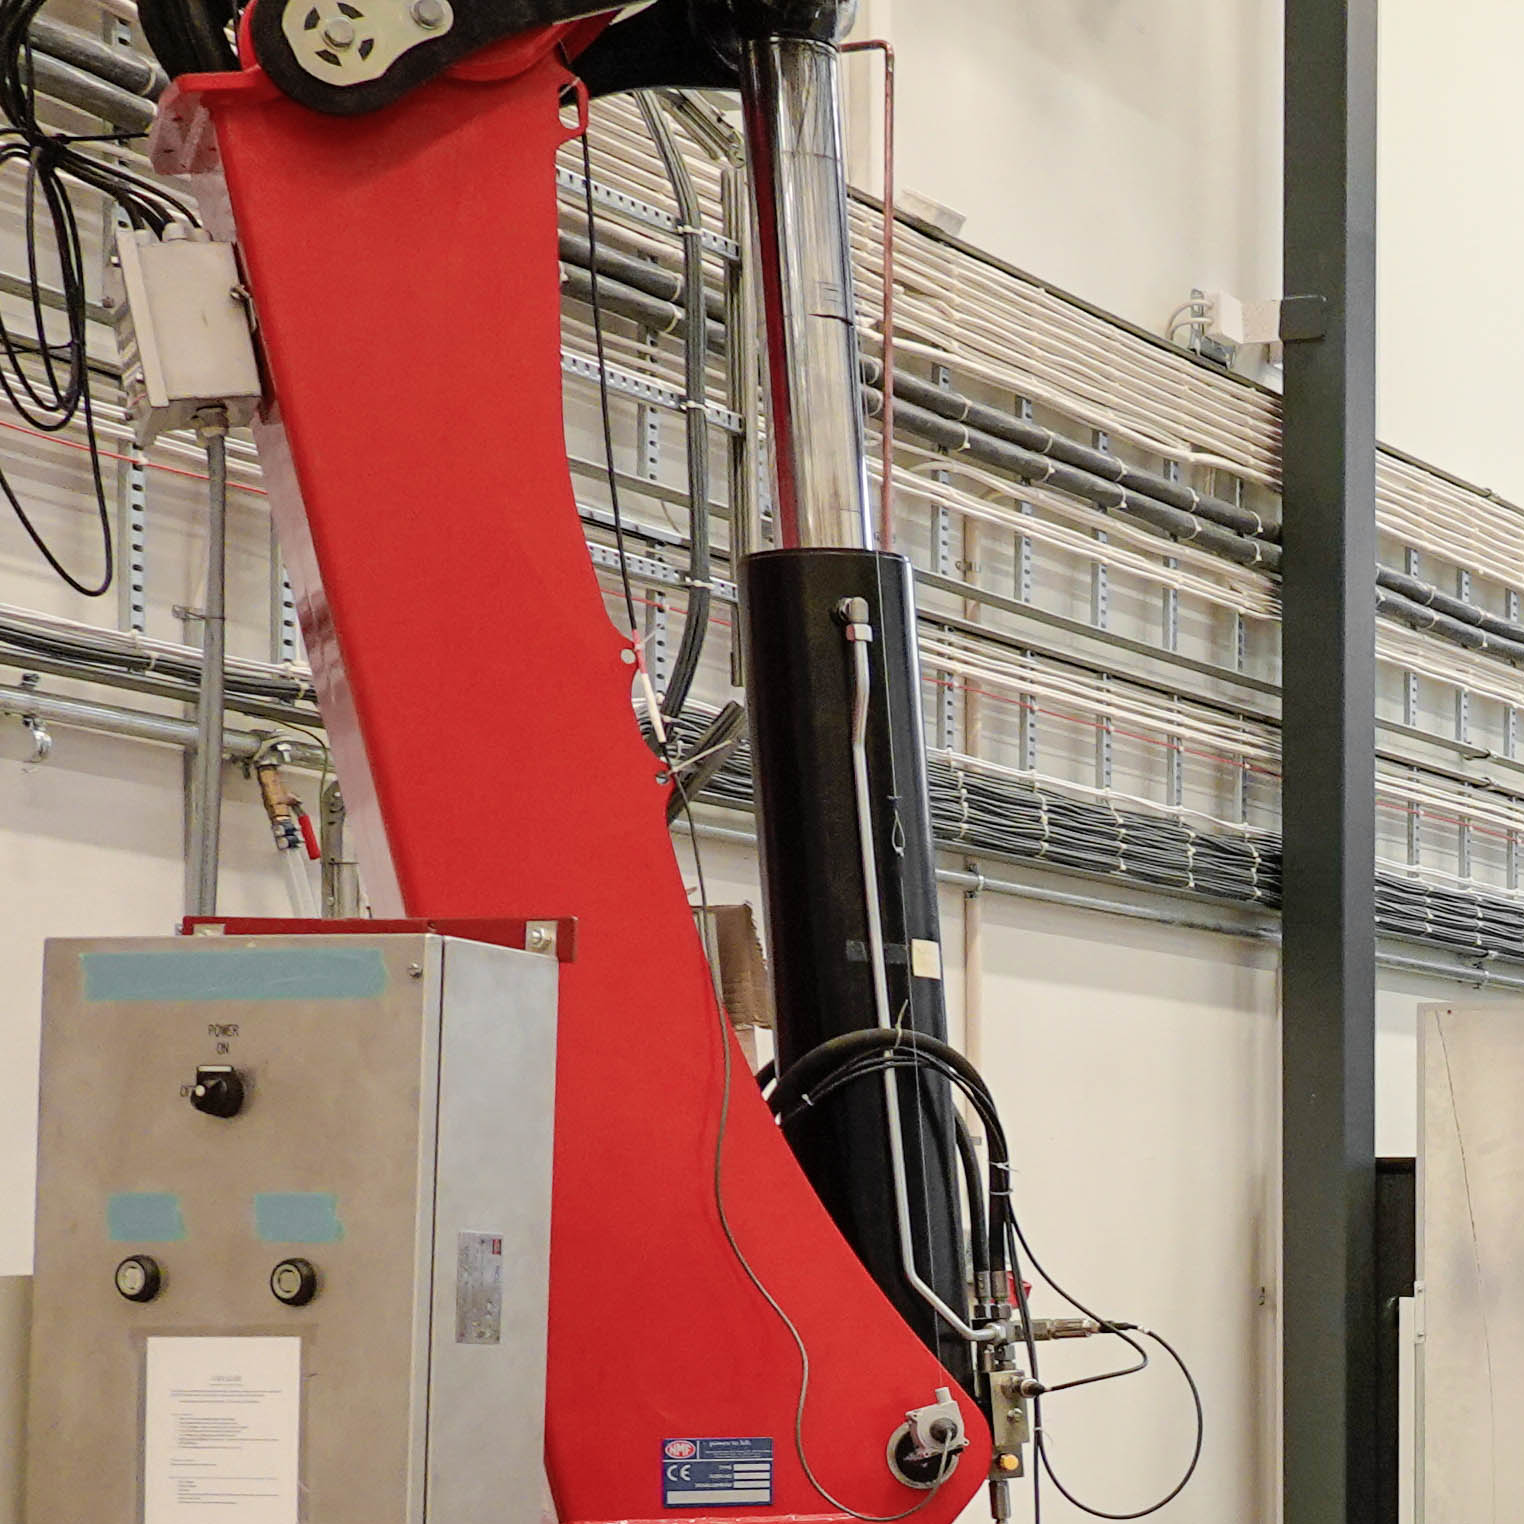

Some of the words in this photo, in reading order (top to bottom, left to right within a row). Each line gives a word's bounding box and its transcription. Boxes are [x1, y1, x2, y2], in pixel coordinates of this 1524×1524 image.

[207, 1023, 240, 1037] POWER
[216, 1041, 230, 1055] ON
[667, 1464, 691, 1481] CE
